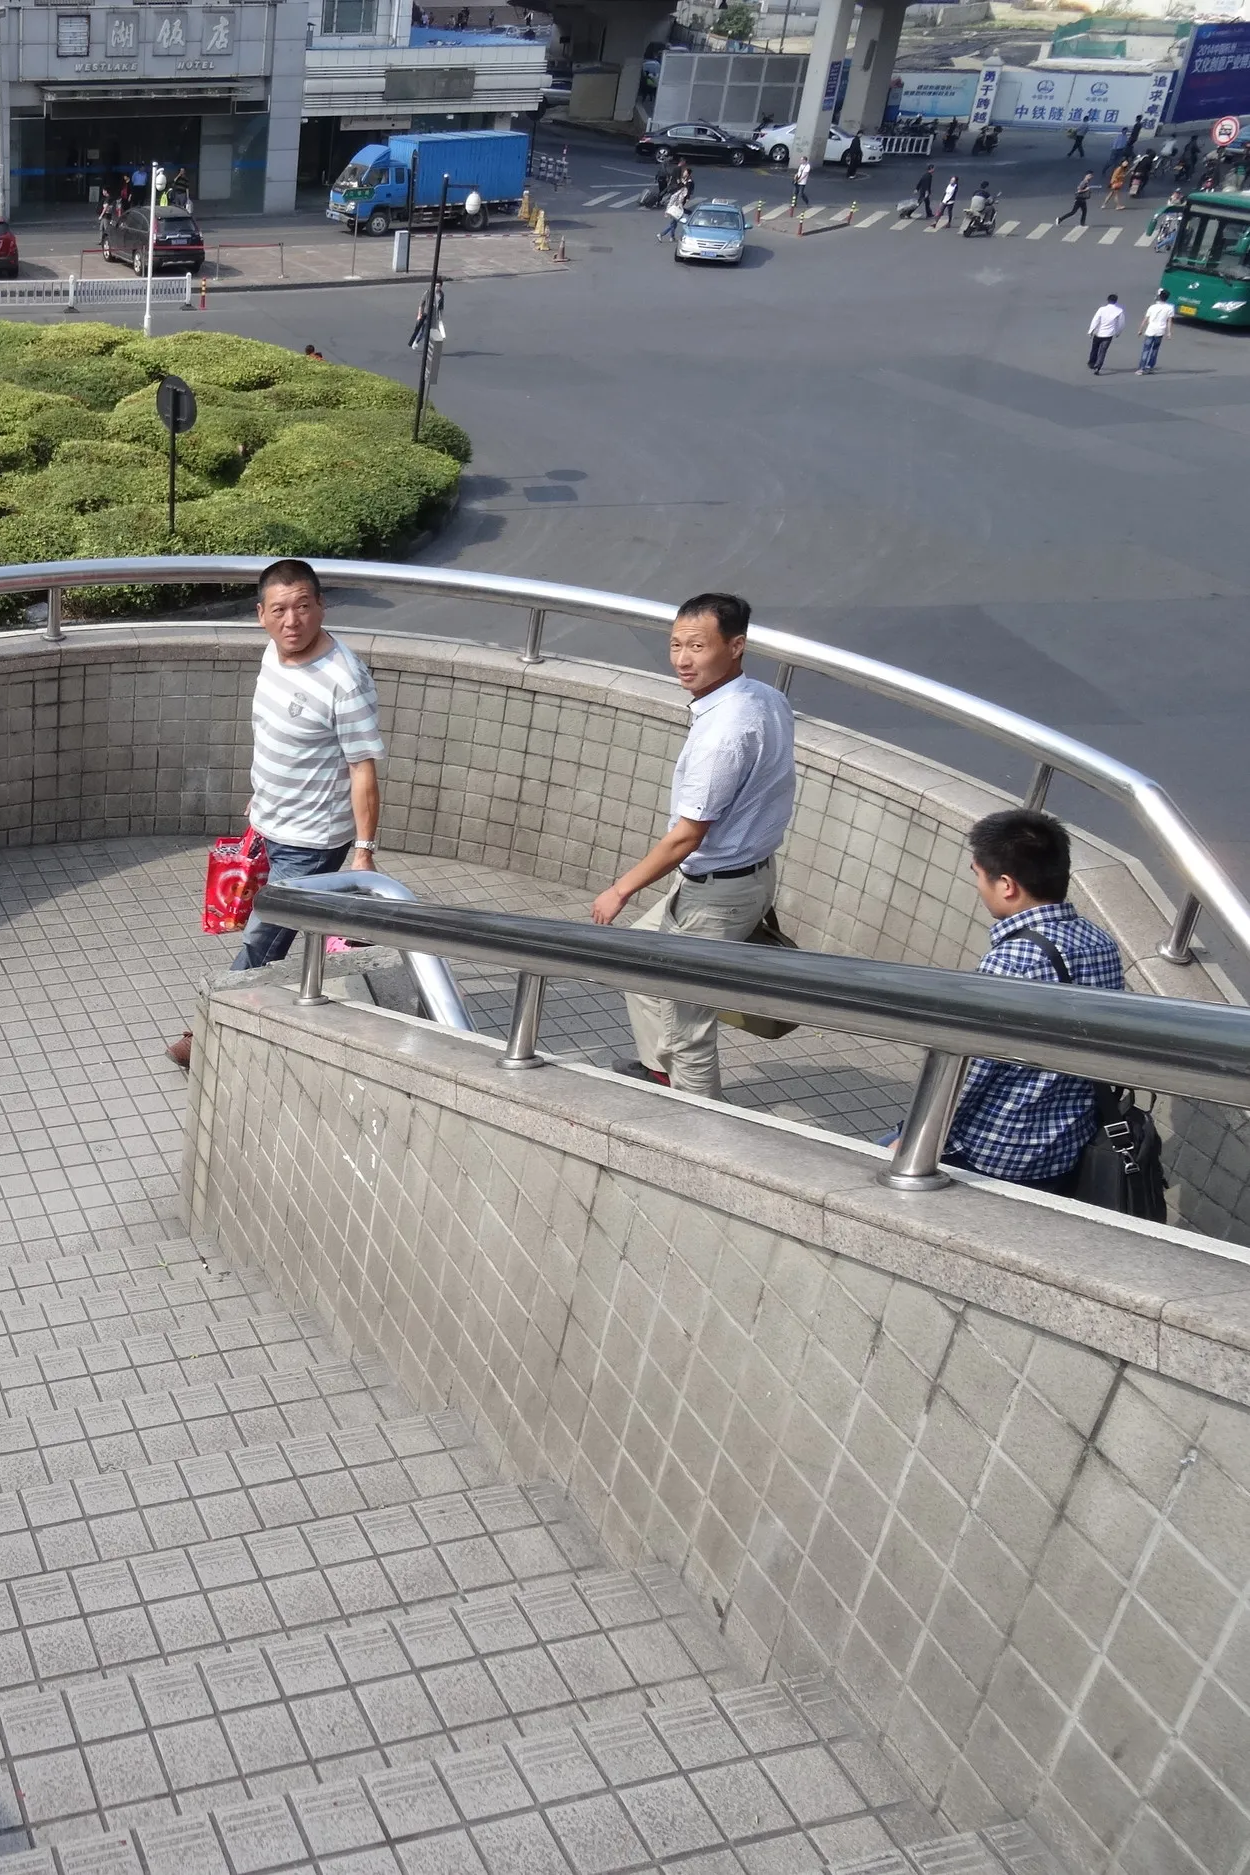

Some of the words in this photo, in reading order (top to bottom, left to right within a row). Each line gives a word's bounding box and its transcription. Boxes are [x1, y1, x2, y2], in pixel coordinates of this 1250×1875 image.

[74, 62, 139, 73] WESTLAKE
[176, 60, 216, 71] HOTEL
[972, 70, 997, 124] 勇于跨越
[1014, 104, 1120, 124] 中铁隧道集团
